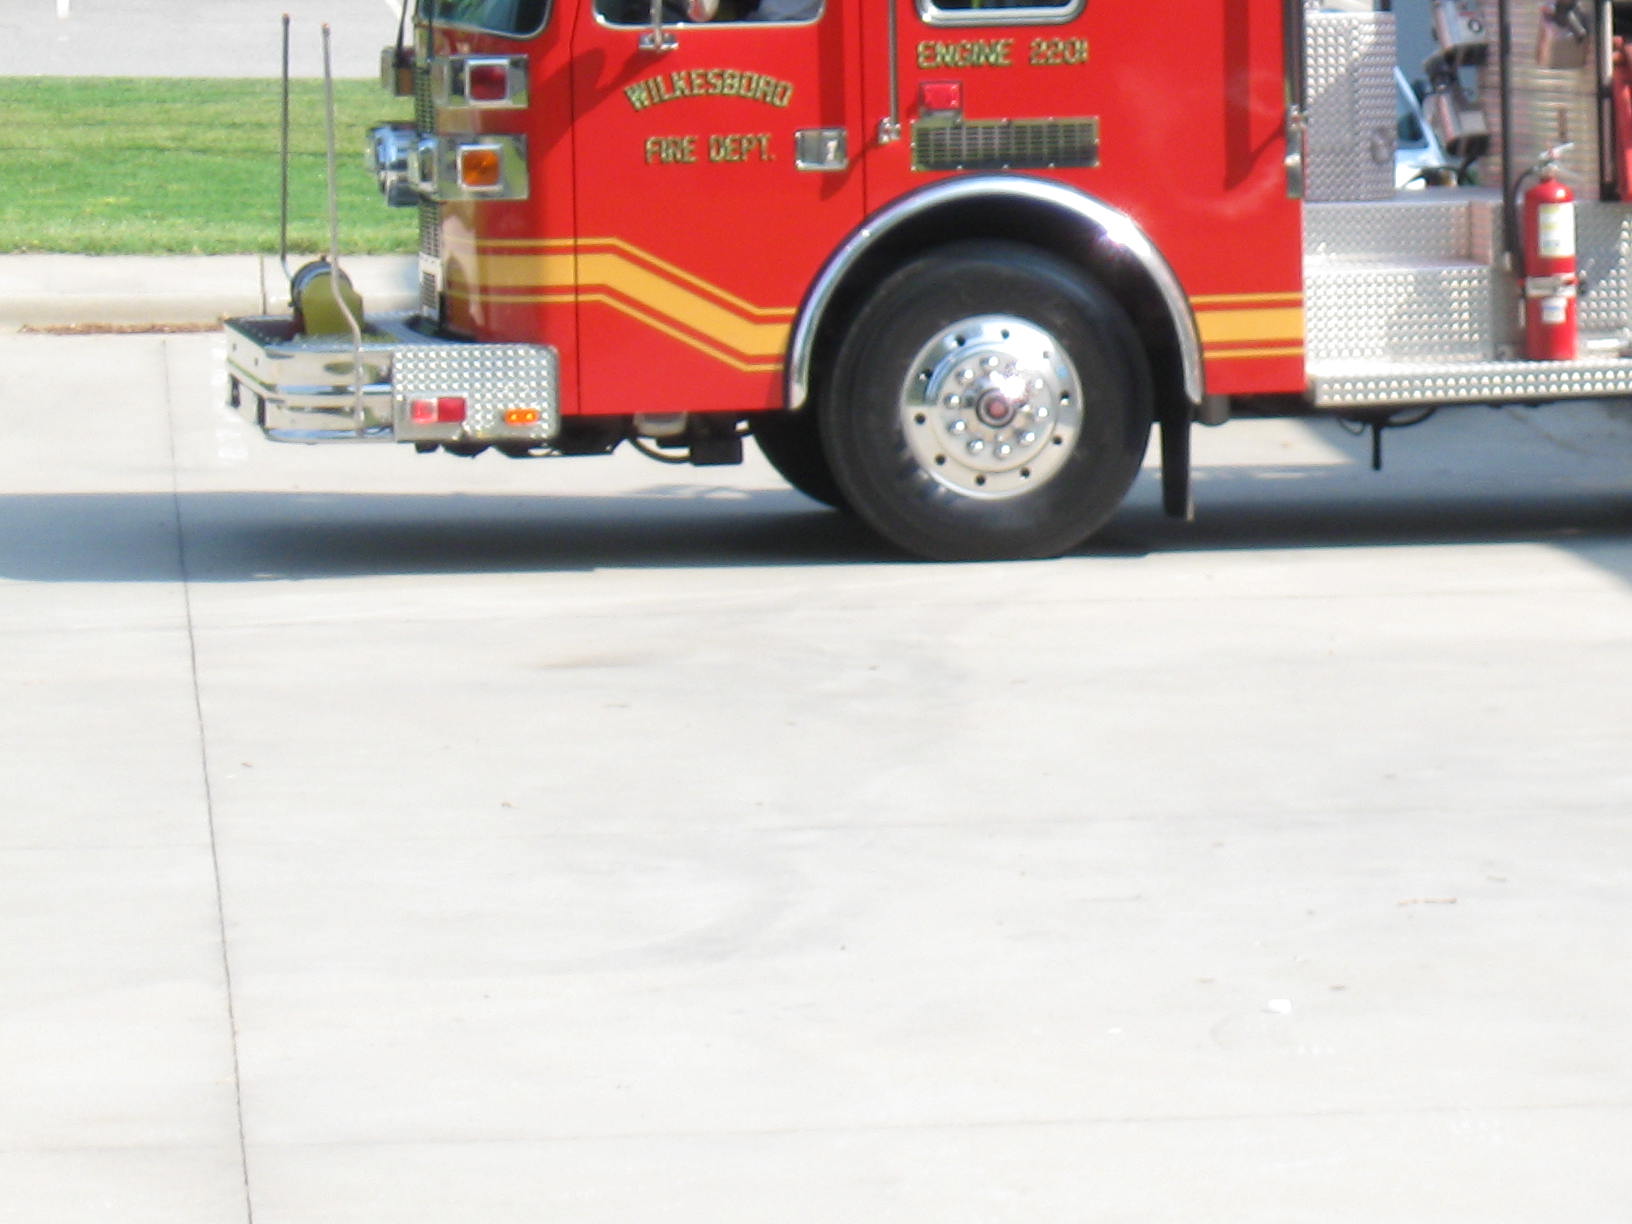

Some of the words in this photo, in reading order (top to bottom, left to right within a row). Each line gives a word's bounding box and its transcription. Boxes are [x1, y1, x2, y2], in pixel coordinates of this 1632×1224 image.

[917, 38, 1015, 69] ENGINE
[1030, 36, 1089, 66] 2201
[623, 68, 793, 111] WILKESBORO
[645, 135, 698, 164] FIRE
[709, 133, 776, 163] DEPT.
